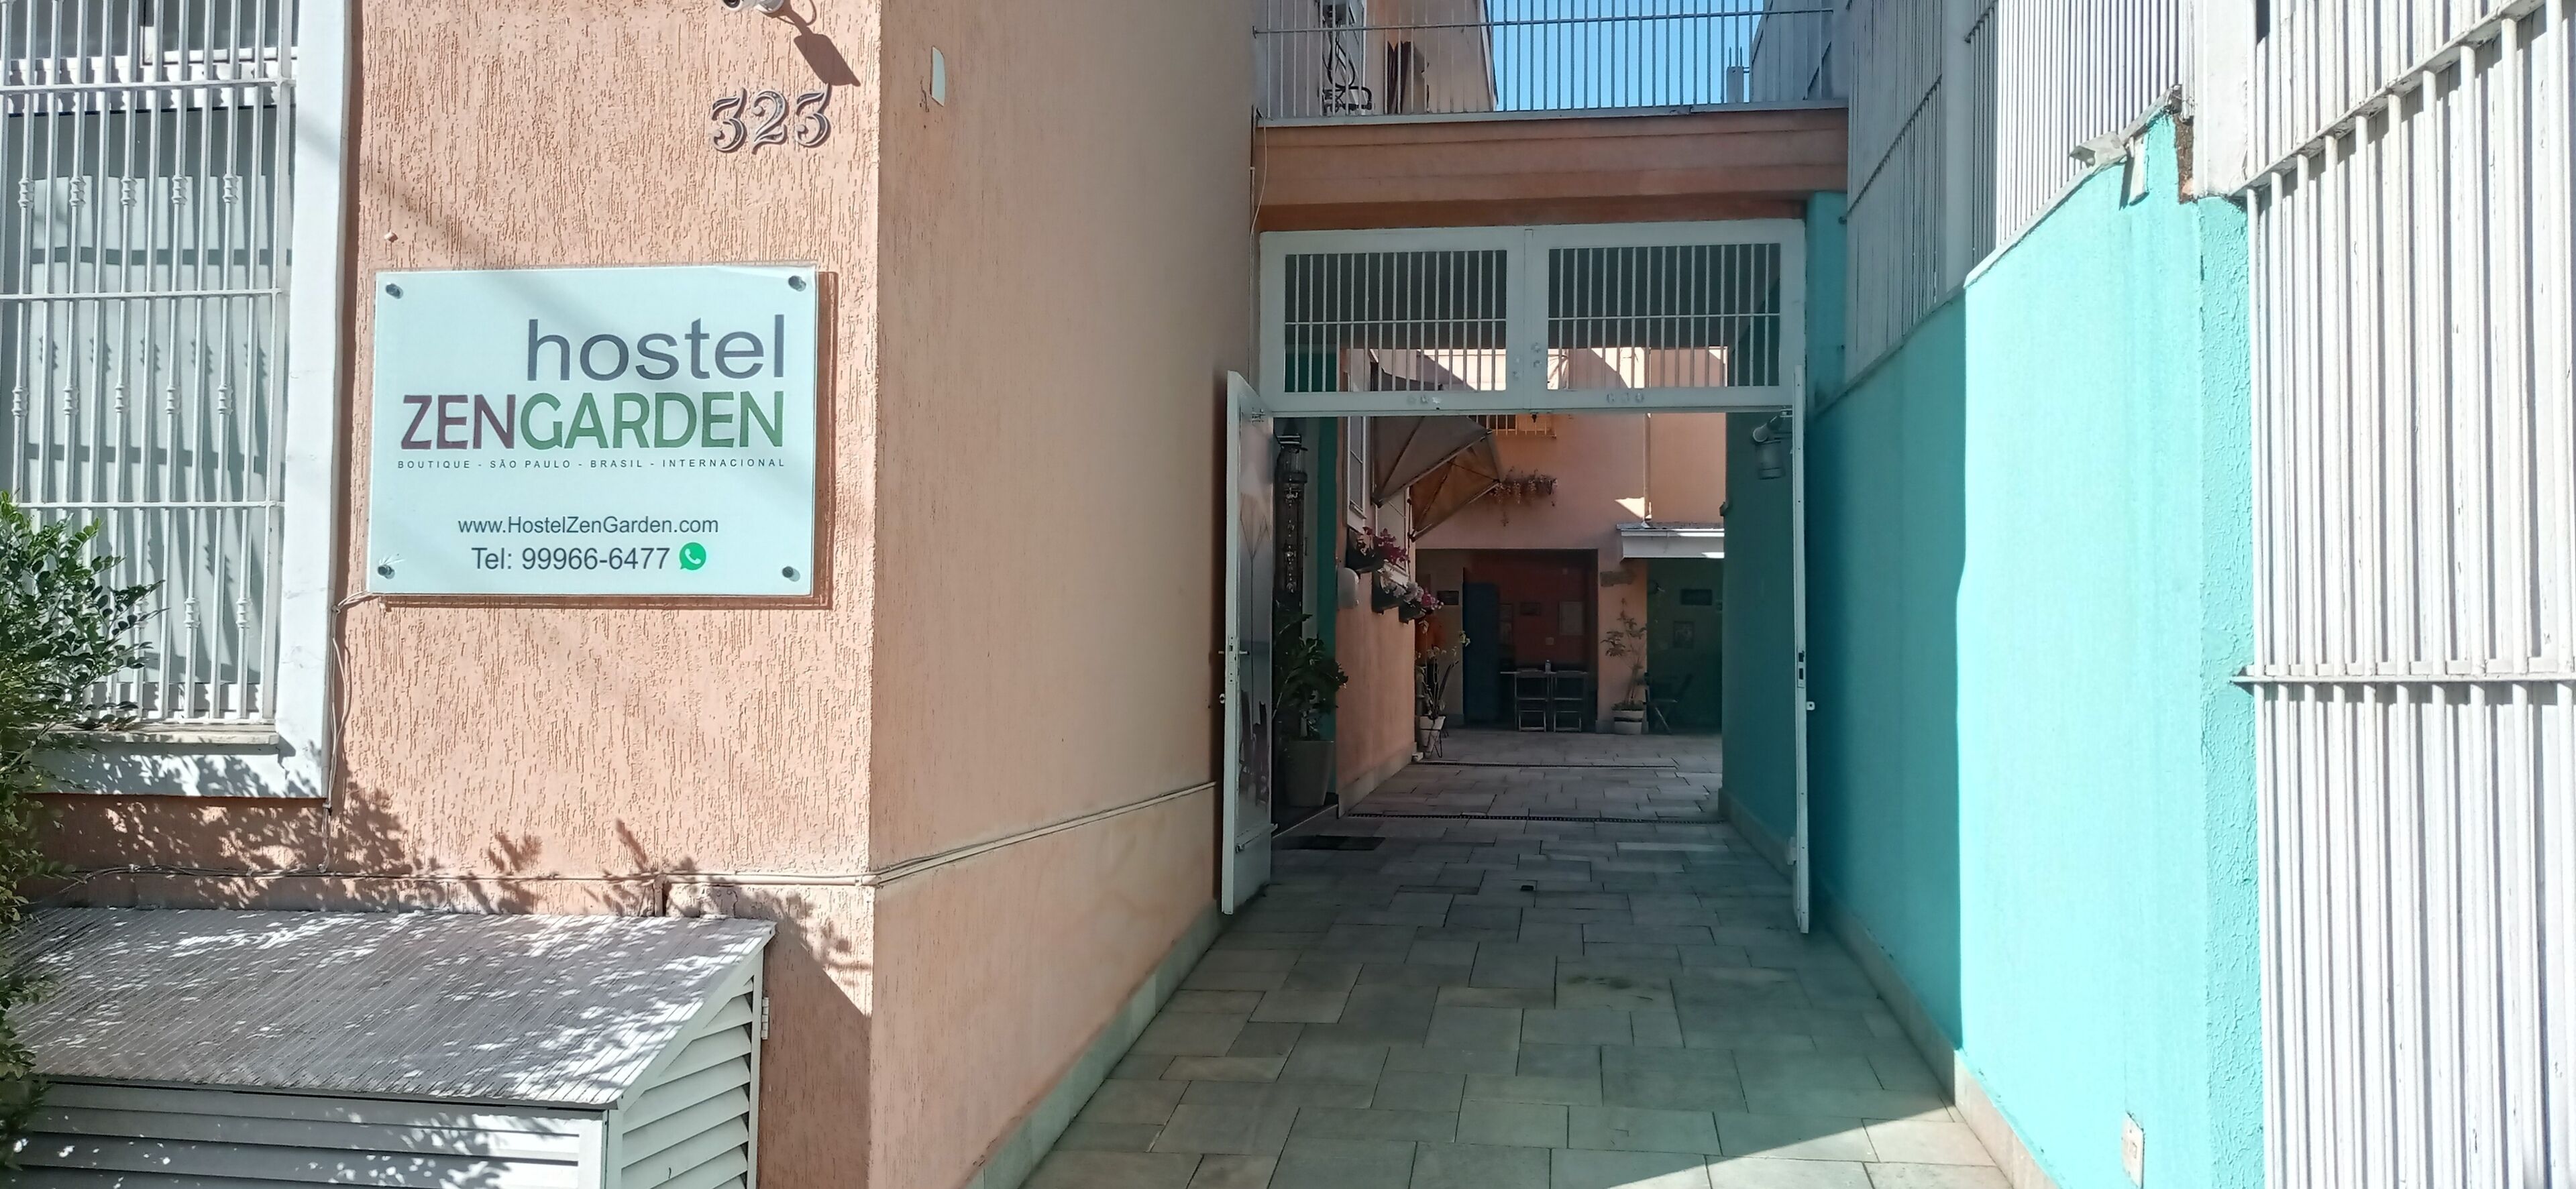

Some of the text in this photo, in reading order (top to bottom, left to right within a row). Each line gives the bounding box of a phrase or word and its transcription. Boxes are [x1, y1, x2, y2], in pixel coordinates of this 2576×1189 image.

[711, 83, 830, 152] 323
[527, 314, 785, 382] hostel
[400, 390, 784, 451] ZENGARDEN
[397, 460, 470, 469] BOUTIQUE
[490, 457, 517, 468] SÃO
[525, 459, 570, 468] PAULO
[590, 459, 643, 468] BRASIL
[662, 458, 785, 468] INTERNACIONAL
[458, 515, 719, 534] www.HostelZenGarden.com
[470, 547, 671, 570] Tel: 99966-6477
